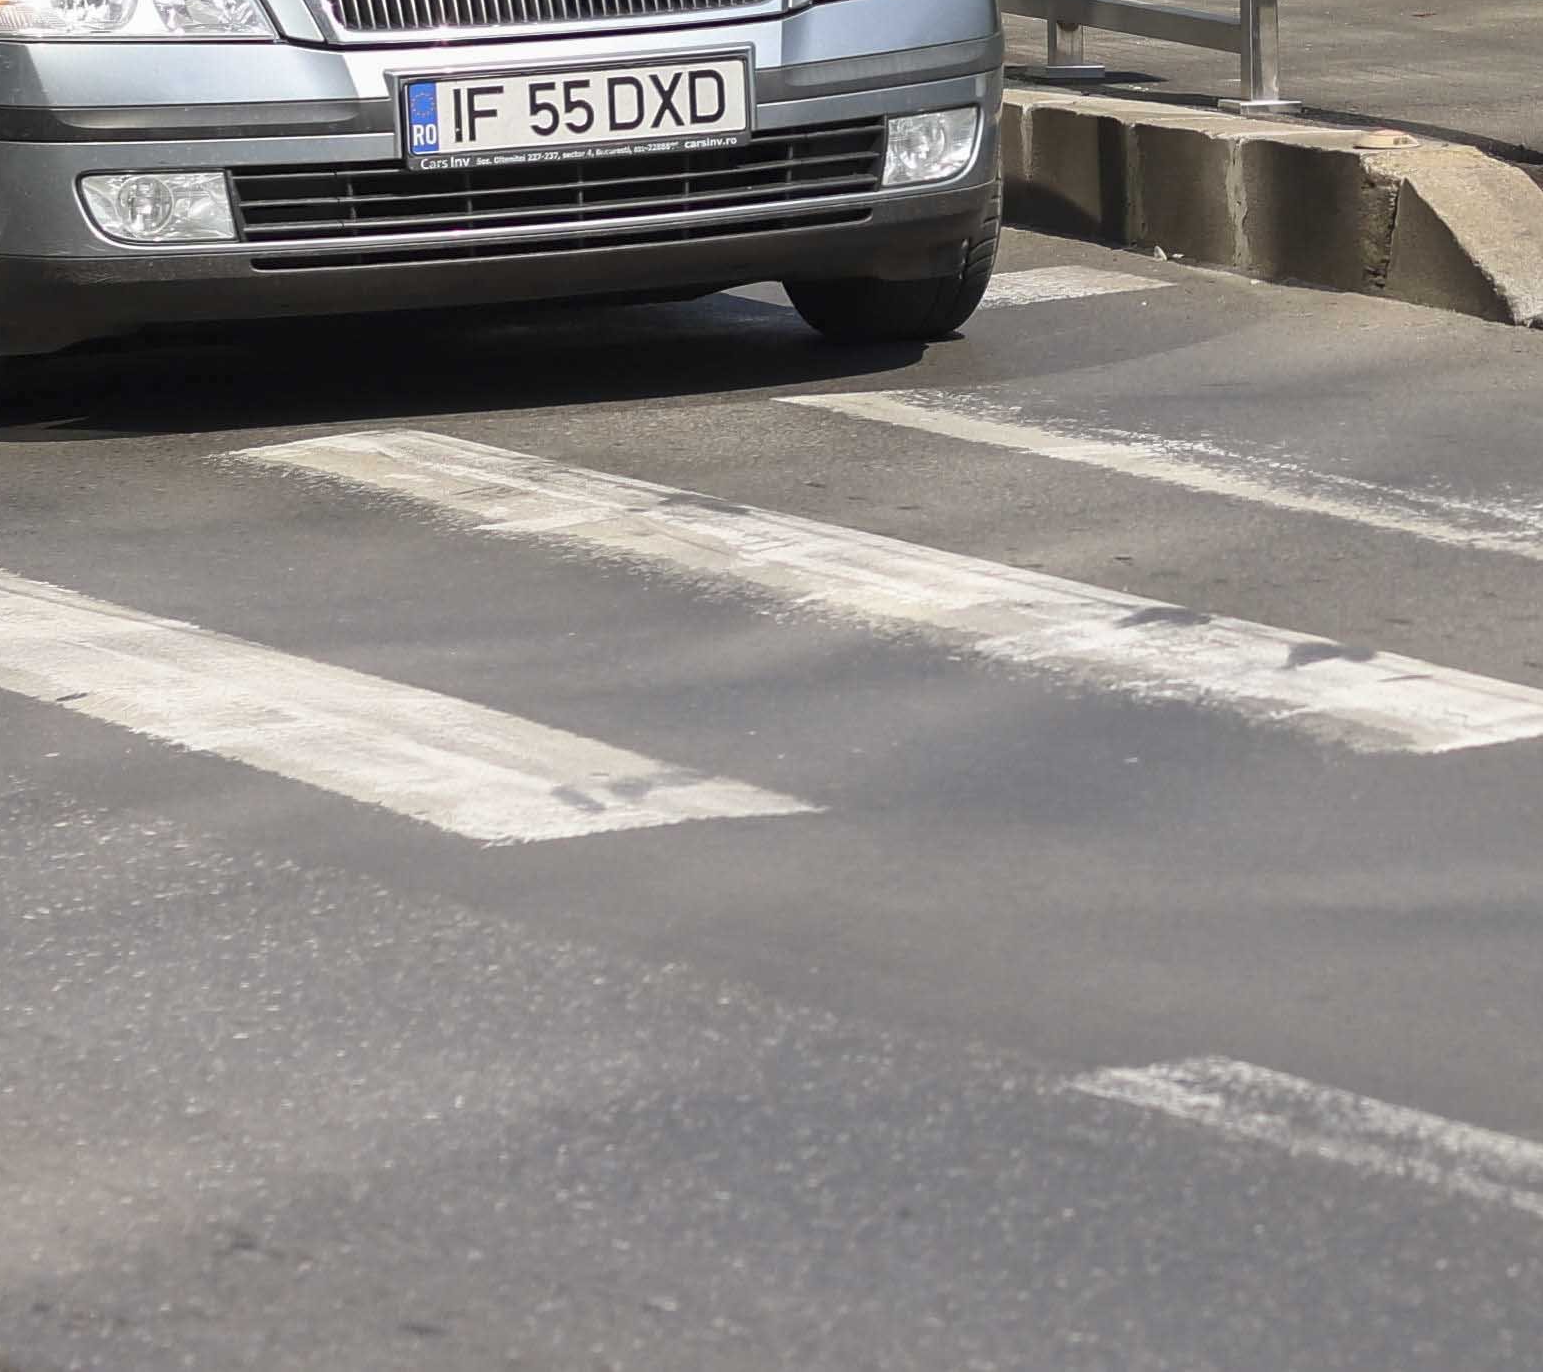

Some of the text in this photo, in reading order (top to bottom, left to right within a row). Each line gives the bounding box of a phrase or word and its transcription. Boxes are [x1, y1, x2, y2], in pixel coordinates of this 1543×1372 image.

[453, 69, 726, 144] IF 55 DXD
[413, 124, 437, 146] RO
[420, 156, 471, 170] Cars Inv
